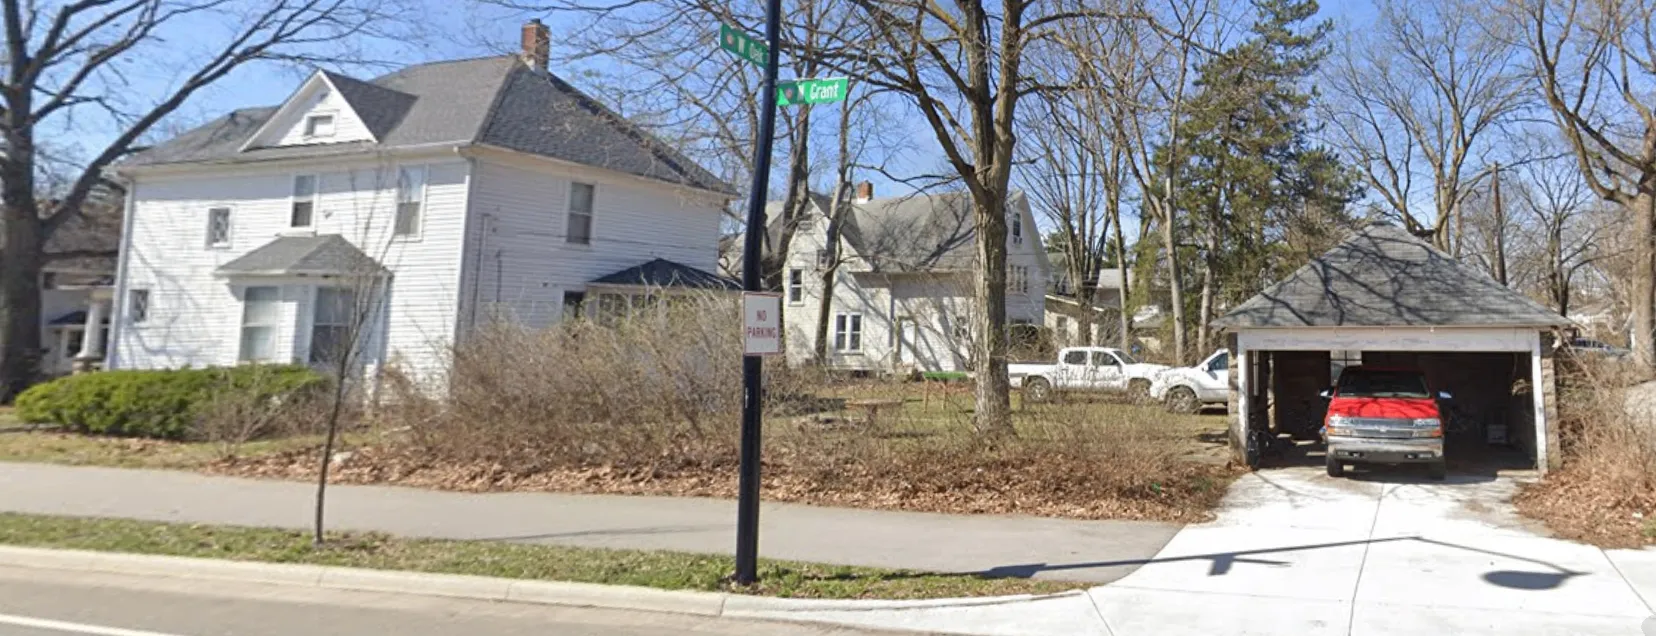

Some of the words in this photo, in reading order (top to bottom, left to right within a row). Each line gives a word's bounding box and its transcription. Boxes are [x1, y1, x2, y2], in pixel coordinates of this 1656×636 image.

[810, 82, 839, 100] Grant
[756, 310, 767, 321] NO
[747, 326, 776, 338] PARKING
